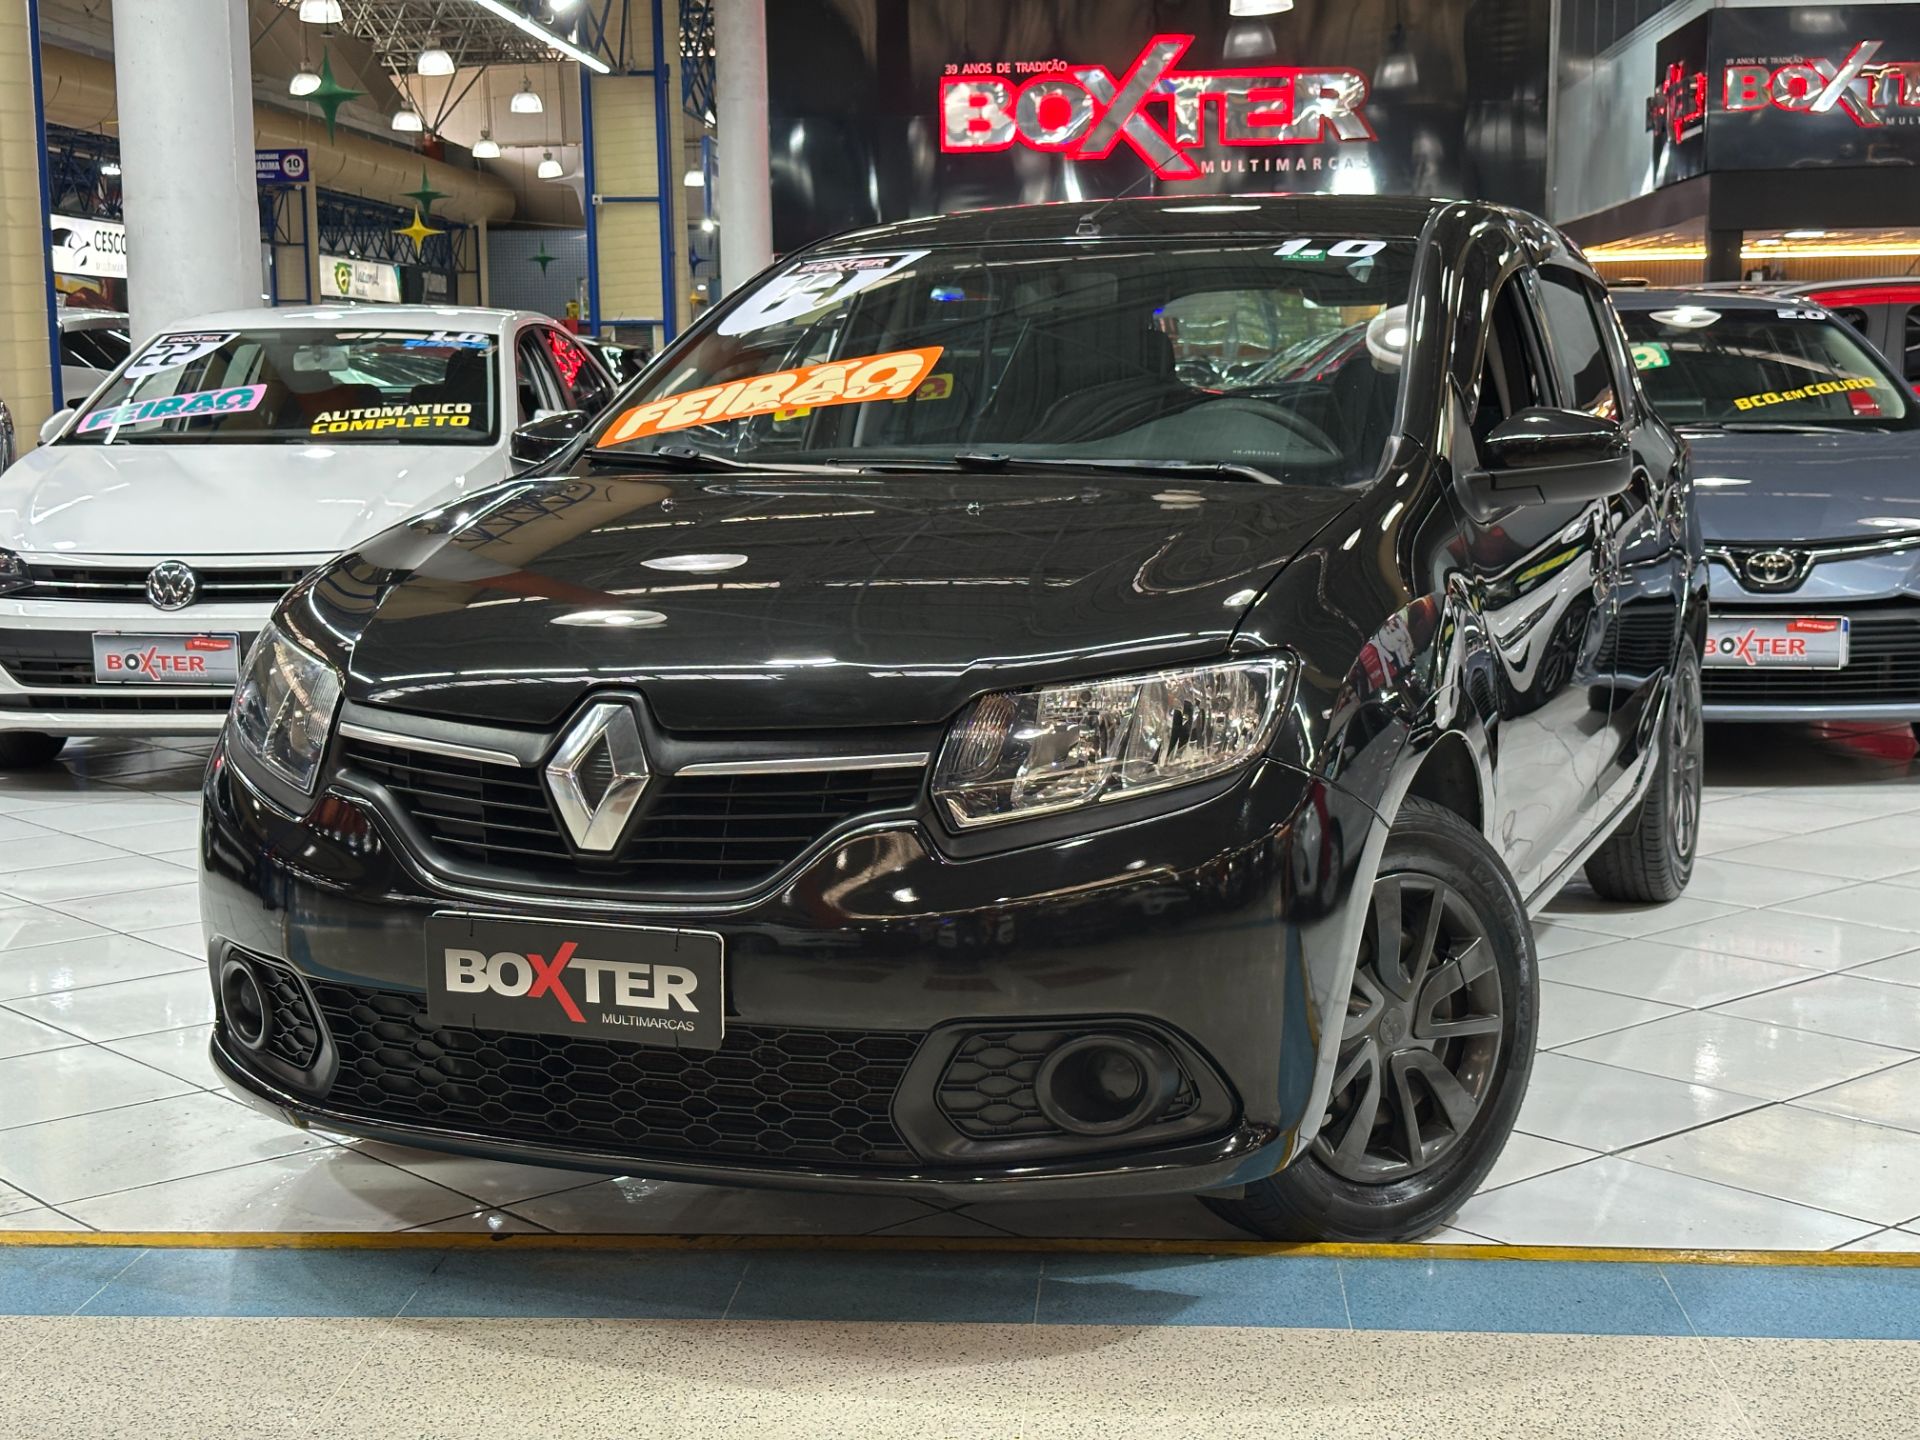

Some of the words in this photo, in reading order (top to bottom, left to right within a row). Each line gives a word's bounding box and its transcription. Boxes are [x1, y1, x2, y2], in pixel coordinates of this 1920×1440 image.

[945, 63, 958, 75] 39
[962, 62, 993, 74] ANOS
[996, 62, 1011, 74] DE
[1015, 58, 1068, 74] TRADIÇÃO
[940, 34, 1377, 180] BOXTER
[286, 158, 300, 168] 10
[1200, 157, 1370, 173] MULTIMARCAS
[1273, 238, 1387, 258] 1.0
[1776, 308, 1826, 320] 2.0
[427, 331, 489, 342] 1.0
[134, 343, 201, 367] 22
[614, 353, 925, 440] FEIRÃO
[1784, 388, 1806, 401] EM
[1803, 377, 1877, 398] COURO
[87, 387, 255, 429] FEIRÃO
[310, 415, 470, 435] COMPLETO
[1704, 628, 1807, 666] BOXTER
[106, 646, 206, 681] BOXTER
[445, 941, 699, 1023] BOXTER
[601, 1013, 695, 1032] MULTIMARCAS
